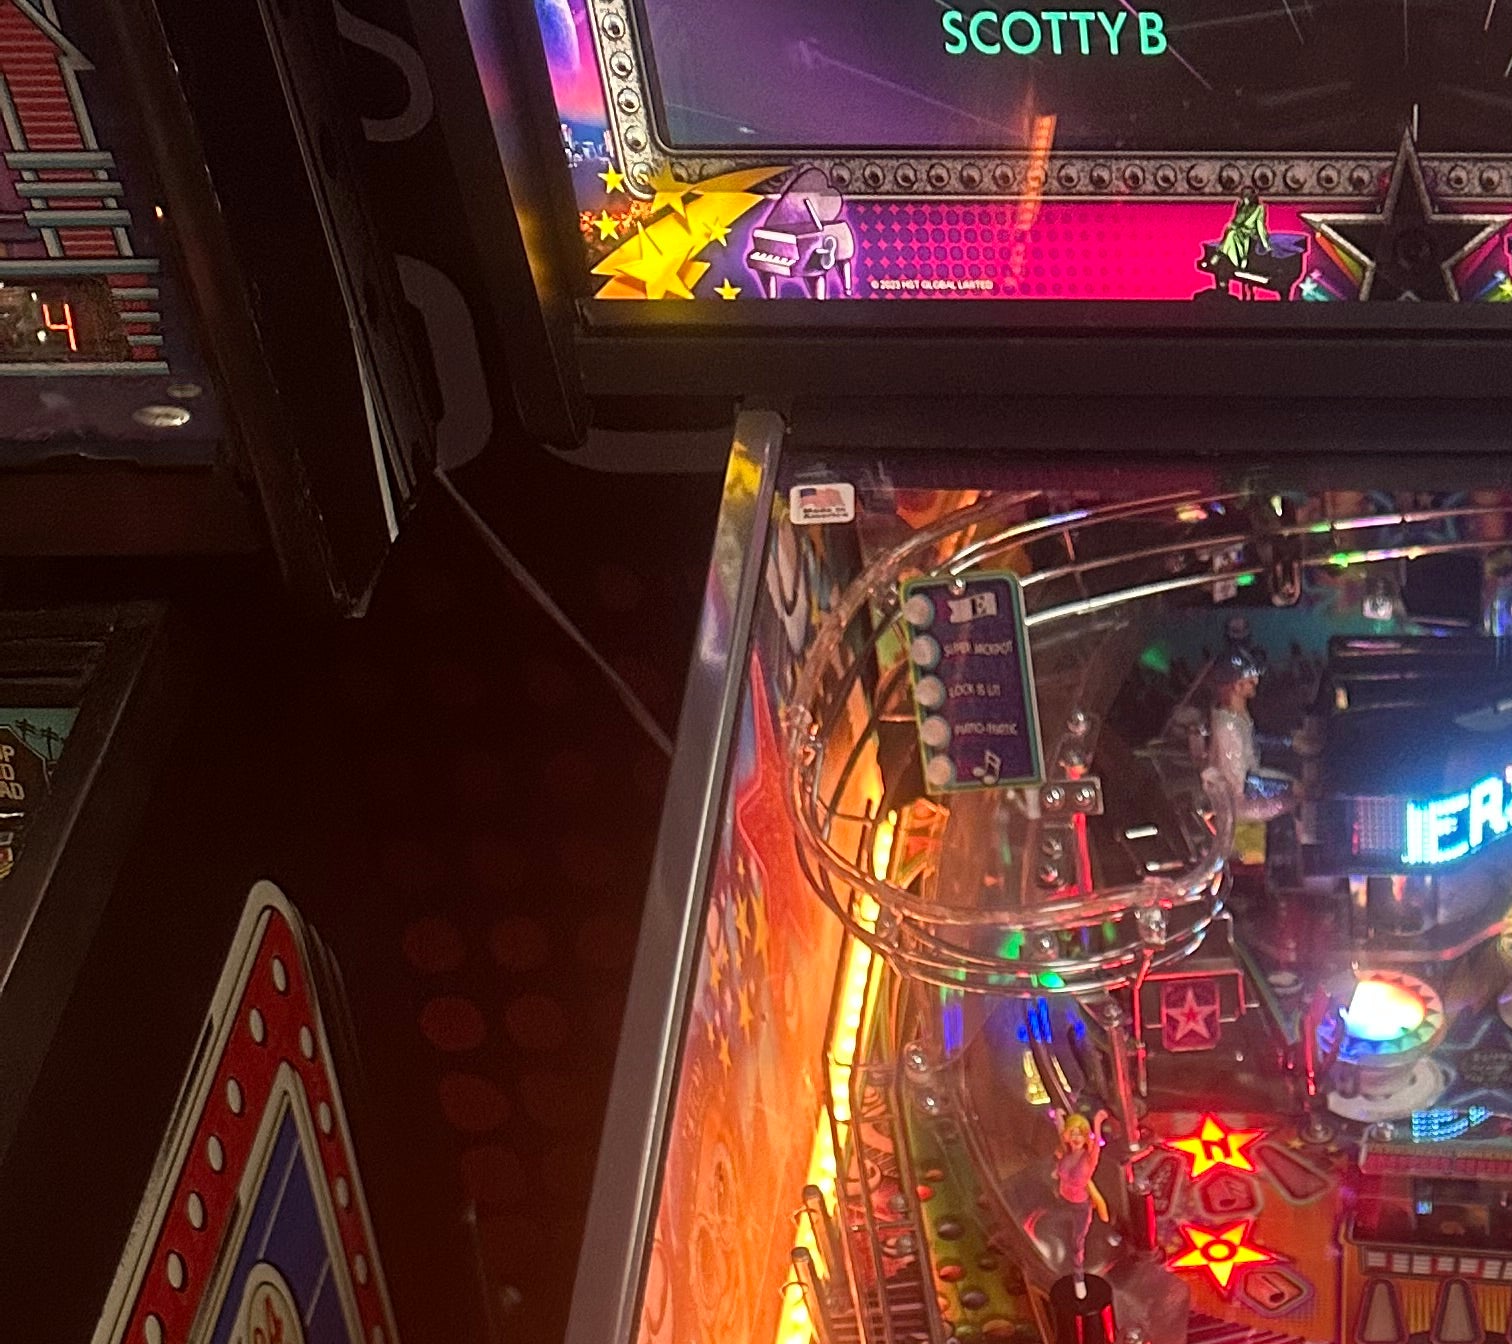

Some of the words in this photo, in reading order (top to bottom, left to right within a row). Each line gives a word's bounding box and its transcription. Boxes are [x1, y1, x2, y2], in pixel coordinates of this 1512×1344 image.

[41, 302, 79, 353] 4
[1205, 1133, 1231, 1160] N
[1203, 1238, 1234, 1263] O
